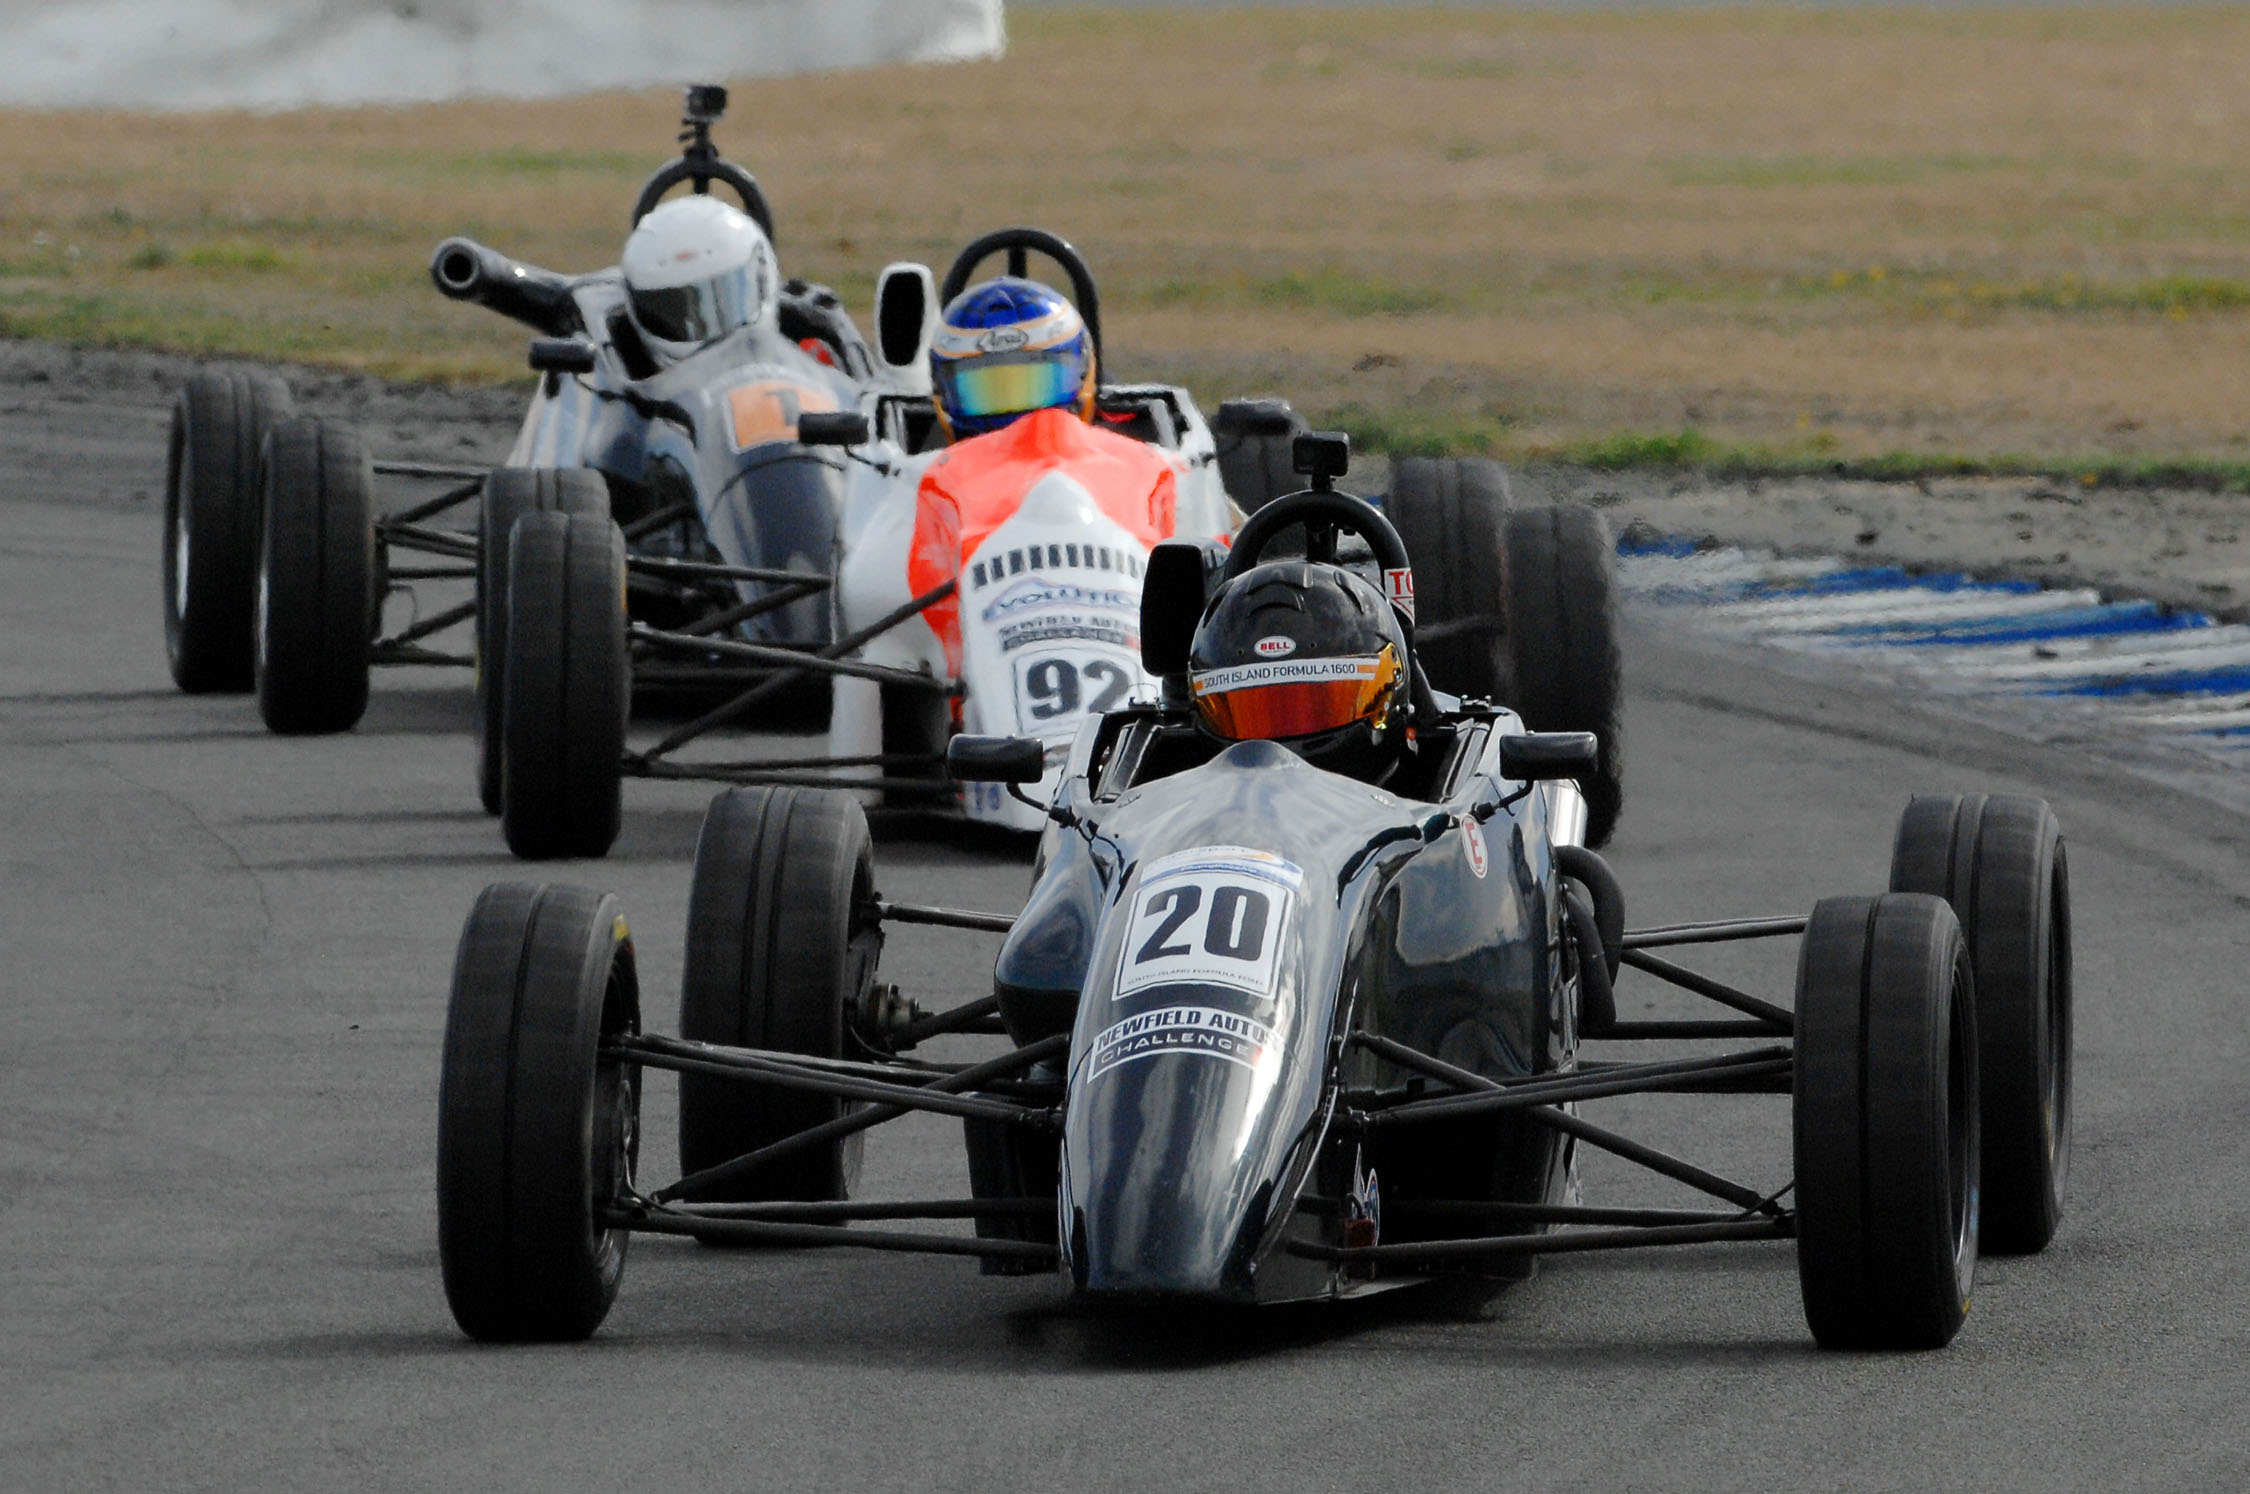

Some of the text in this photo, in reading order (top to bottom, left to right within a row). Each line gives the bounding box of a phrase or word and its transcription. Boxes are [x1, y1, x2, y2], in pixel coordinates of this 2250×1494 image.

[1260, 641, 1290, 651] BELL
[1026, 660, 1129, 720] 92
[1204, 663, 1356, 688] SOUTH ISLAND FORMULA 1600
[1135, 884, 1271, 965] 20
[1097, 1010, 1202, 1052] NEWFIELD
[1101, 1032, 1249, 1064] CHALLENGE
